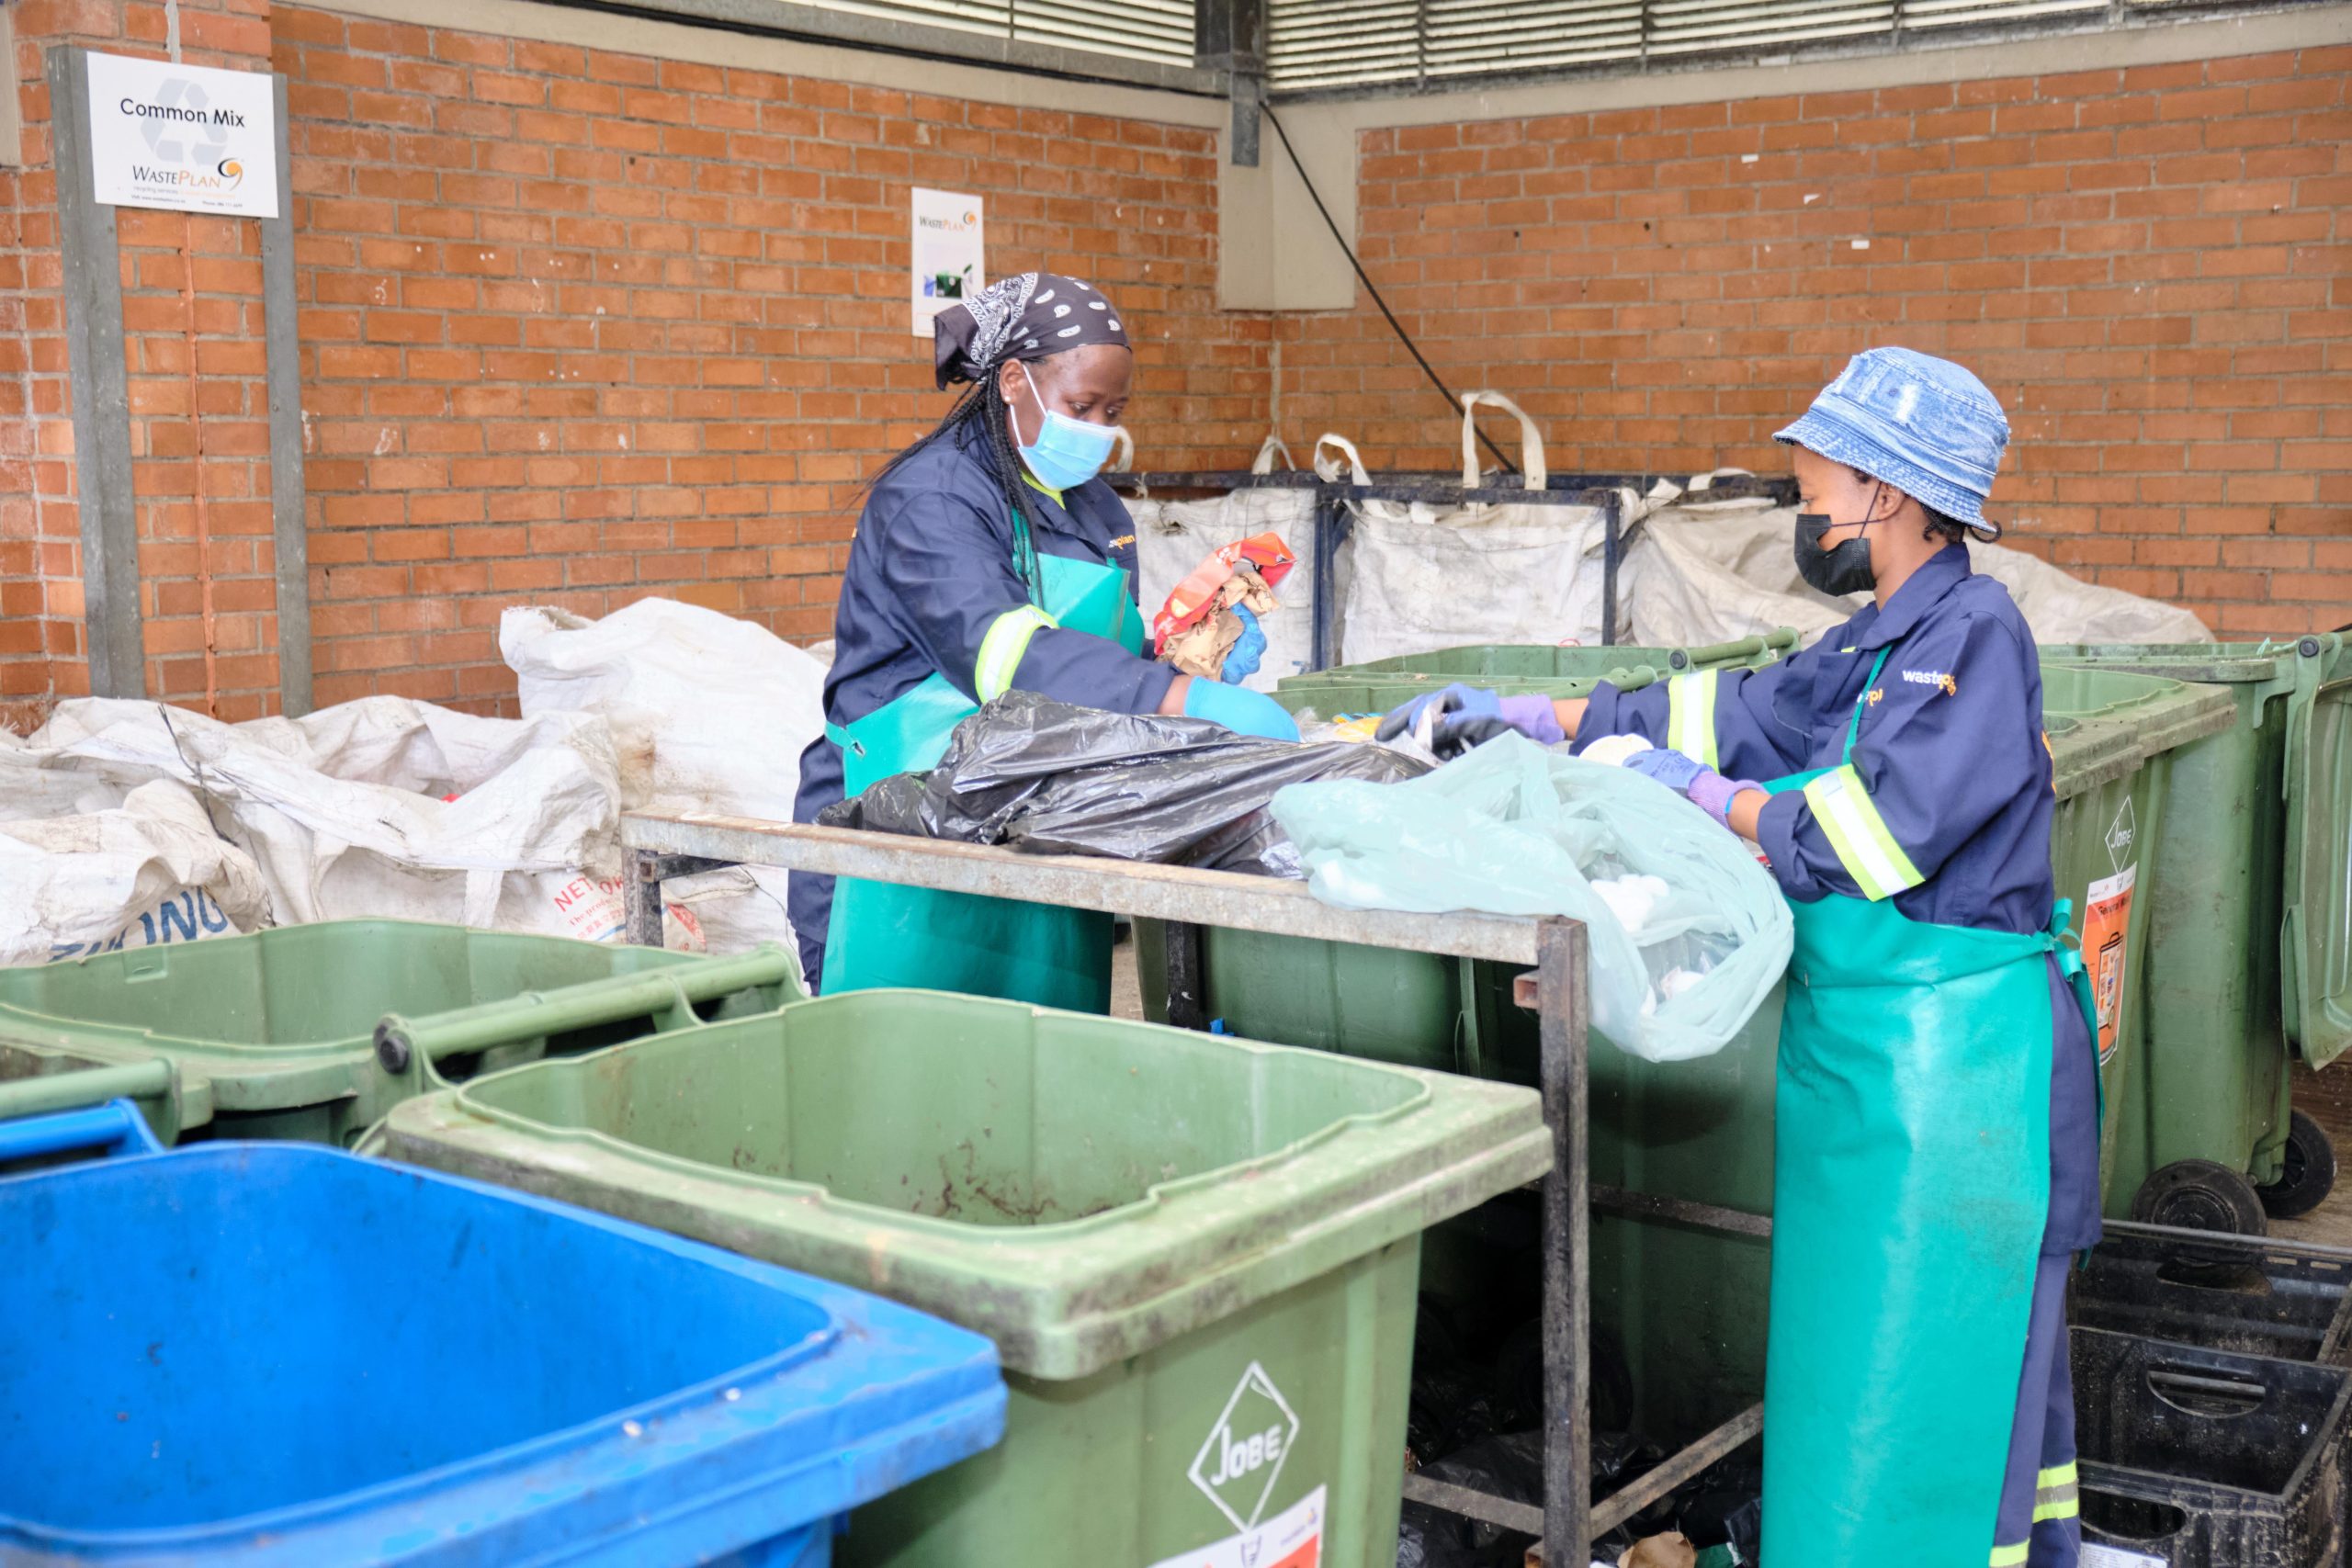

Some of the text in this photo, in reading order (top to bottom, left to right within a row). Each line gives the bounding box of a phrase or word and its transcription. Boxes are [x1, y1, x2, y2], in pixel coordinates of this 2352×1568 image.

[120, 98, 245, 128] Common Mix
[2110, 821, 2132, 849] JOBE
[553, 876, 594, 912] NET
[1209, 1423, 1283, 1487] JOBE
